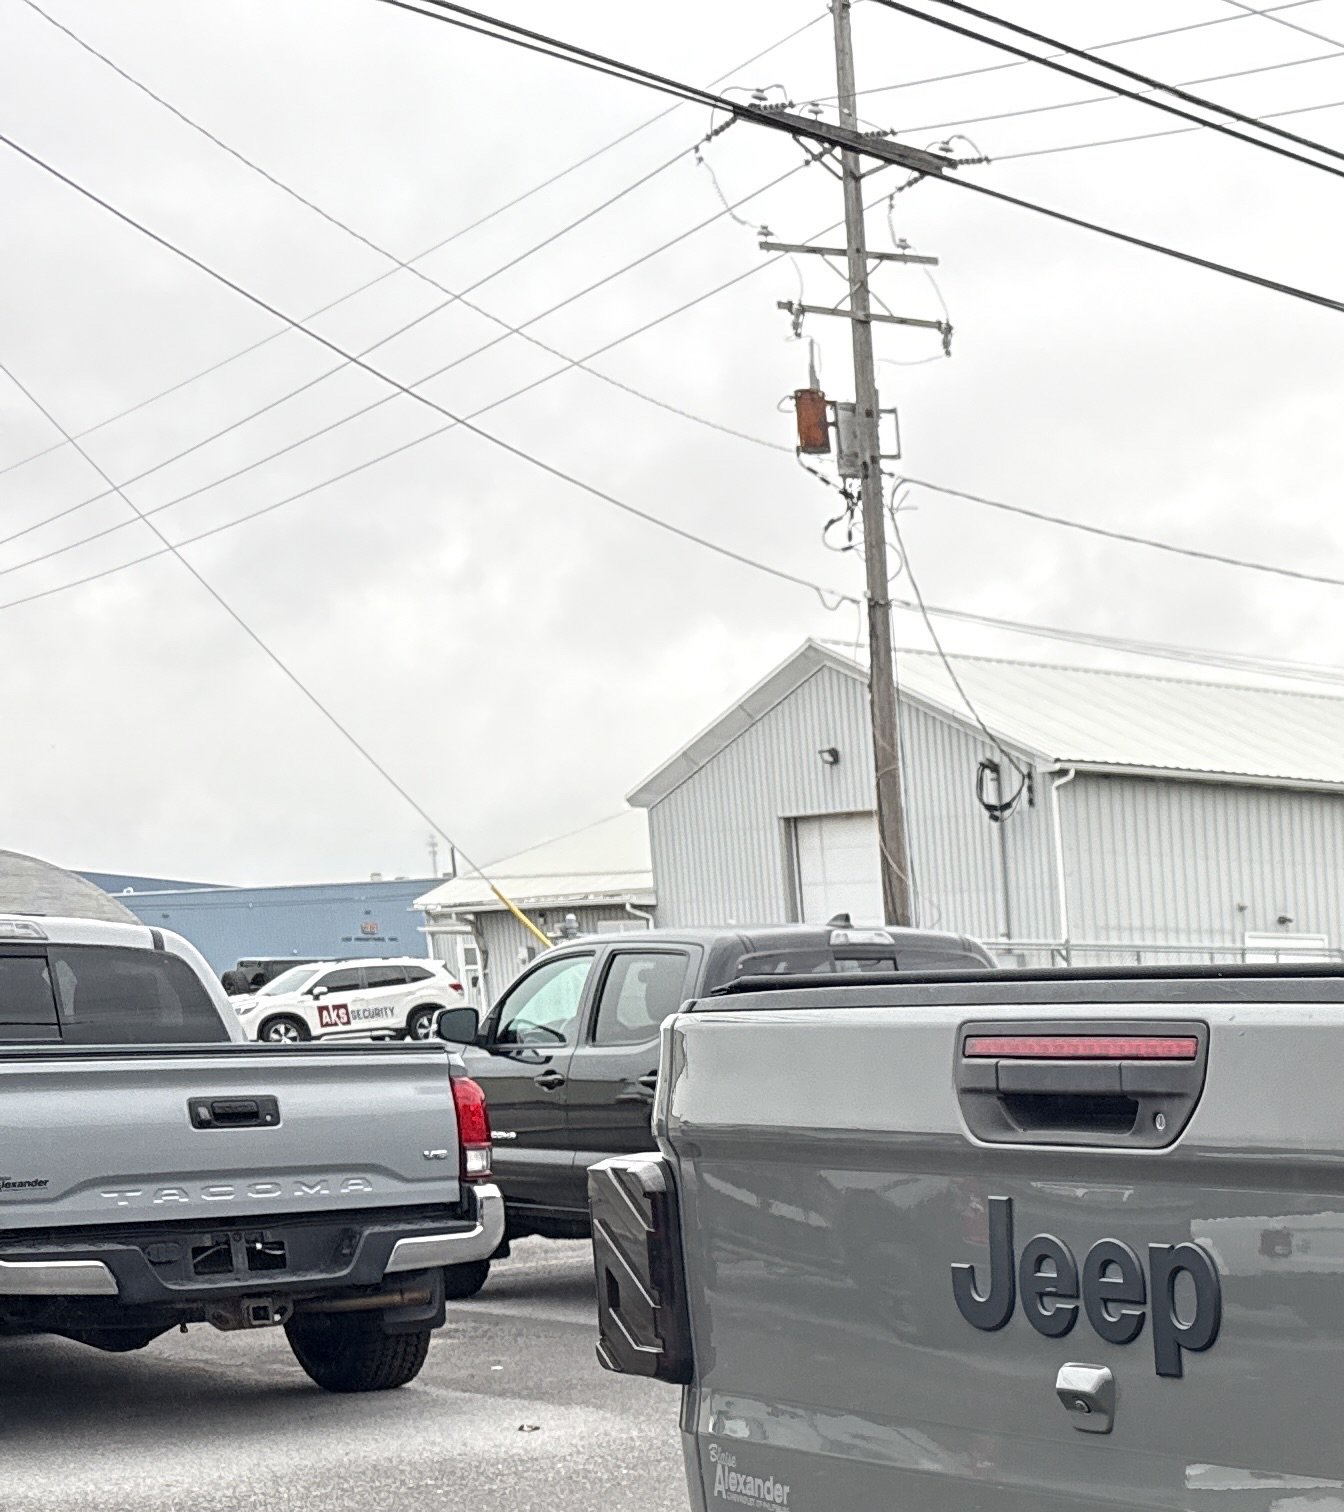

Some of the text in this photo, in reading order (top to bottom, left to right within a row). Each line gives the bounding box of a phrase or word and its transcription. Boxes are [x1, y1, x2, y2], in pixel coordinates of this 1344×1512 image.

[322, 1006, 395, 1026] AKS SECURITY
[0, 1179, 49, 1191] lexander
[100, 1177, 372, 1205] TACOMA
[950, 1195, 1222, 1378] Jeep
[714, 1463, 790, 1505] Alexander
